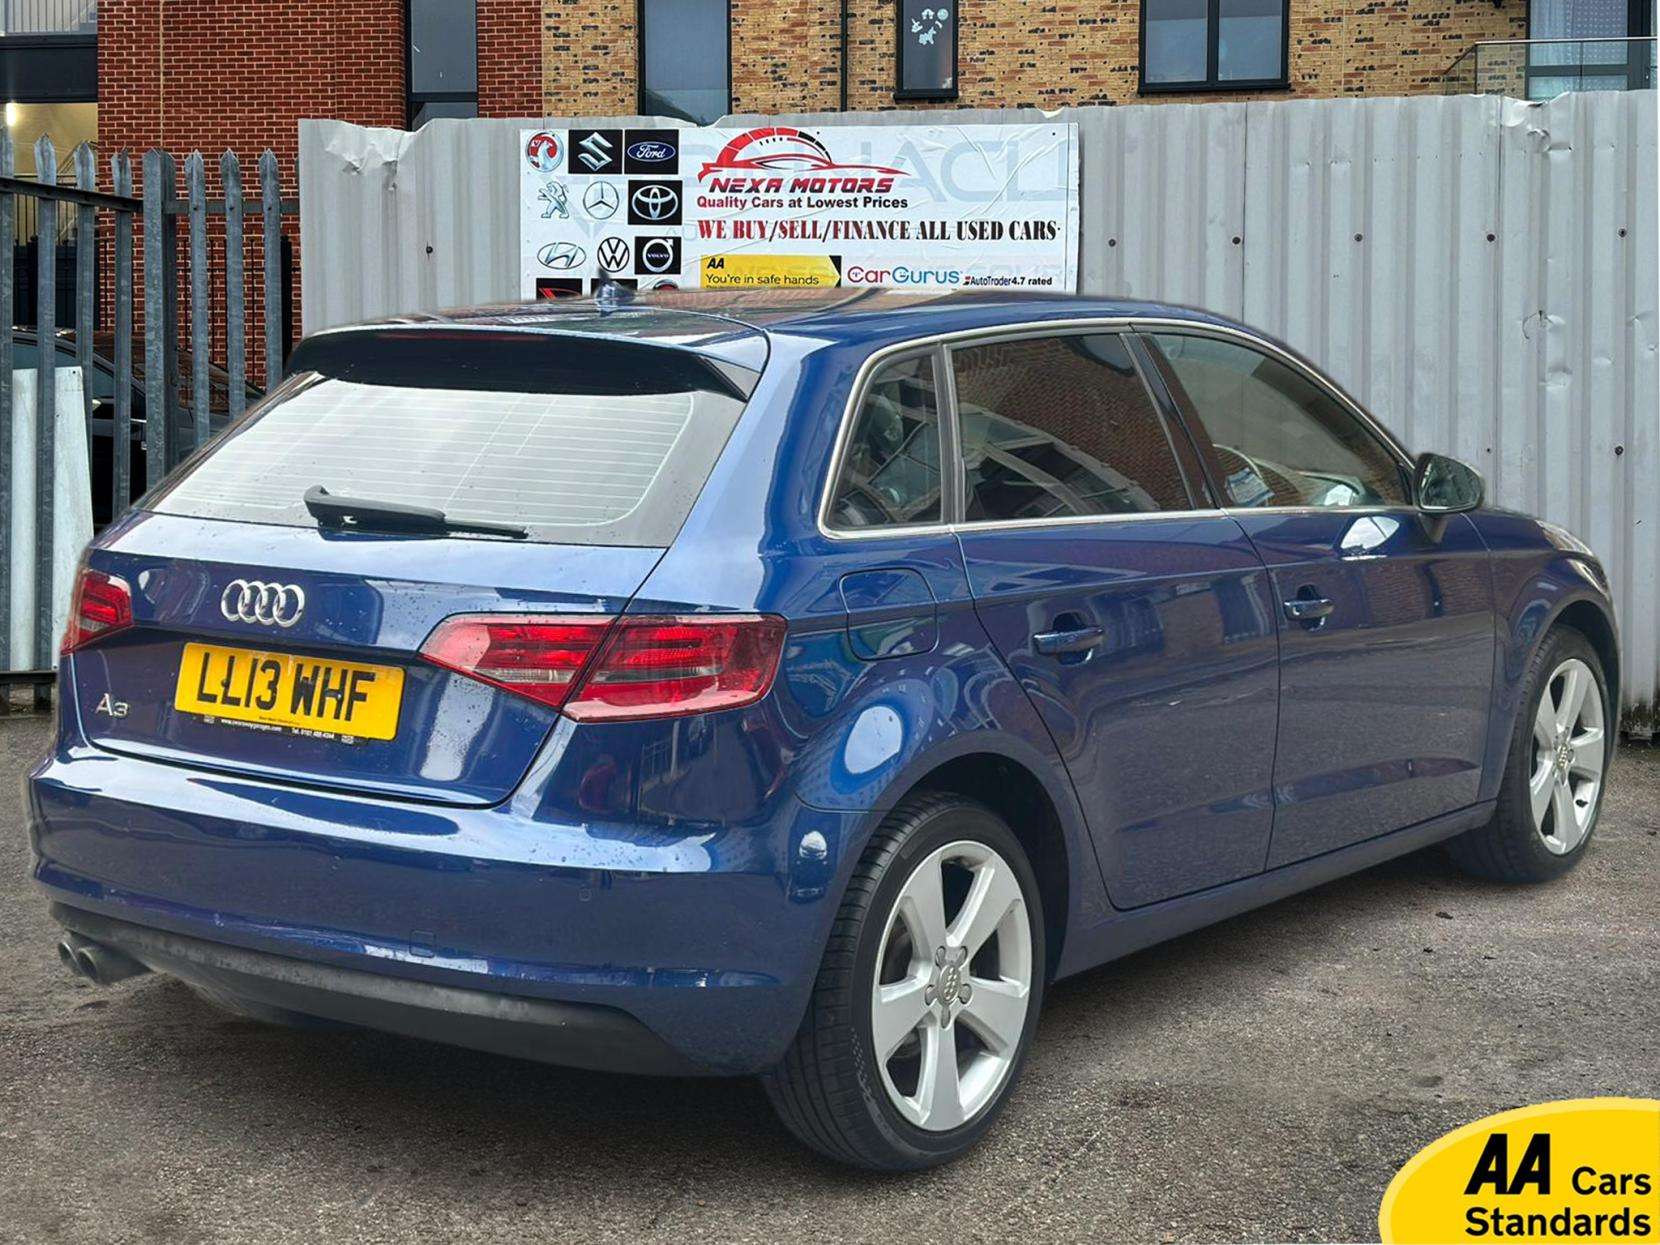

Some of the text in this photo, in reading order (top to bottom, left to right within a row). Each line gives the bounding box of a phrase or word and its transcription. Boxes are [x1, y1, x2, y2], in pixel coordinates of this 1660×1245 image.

[636, 144, 666, 159] Ford
[708, 177, 895, 194] NEXA MOTORS
[697, 196, 908, 209] Quality Cars at Lowest Prices
[698, 221, 728, 240] WE
[915, 221, 951, 240] ALL
[956, 221, 1004, 240] USED
[1008, 221, 1058, 240] CARS
[706, 257, 725, 269] AA
[706, 273, 820, 285] You're in safe hands
[847, 266, 960, 284] CarGurus
[1028, 277, 1053, 286] rated
[196, 652, 375, 722] LL13 WHF
[95, 693, 131, 718] A3
